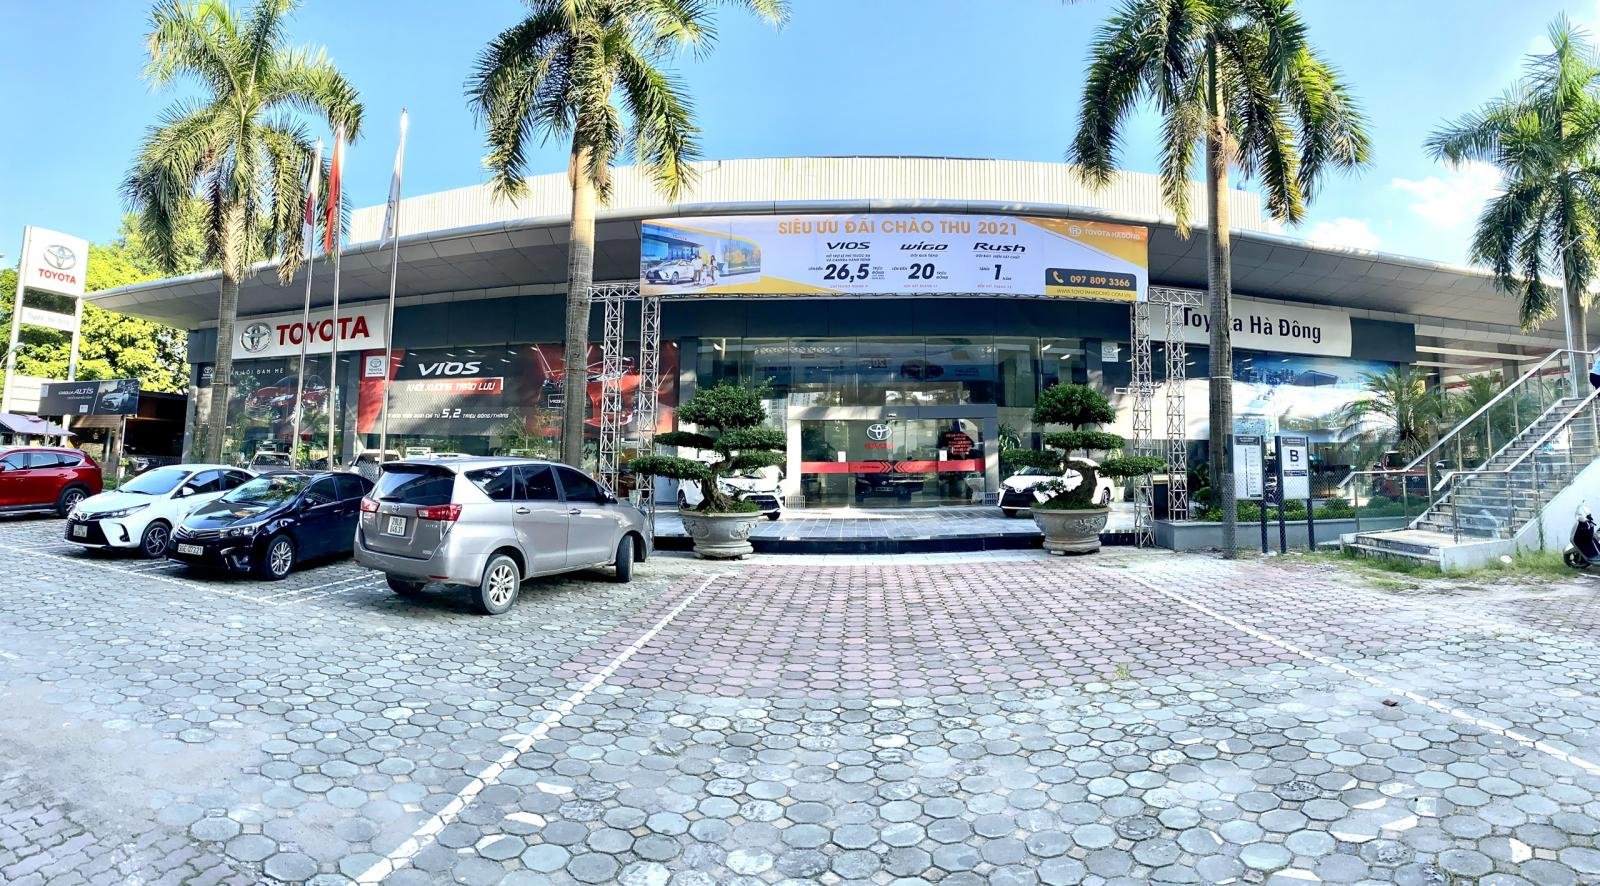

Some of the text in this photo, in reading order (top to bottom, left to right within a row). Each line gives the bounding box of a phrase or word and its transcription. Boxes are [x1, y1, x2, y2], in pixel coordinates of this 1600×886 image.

[778, 217, 1017, 236] SIÊU ƯU ĐÃI CHÀO THU 2021
[827, 241, 871, 250] VIOS
[973, 242, 1026, 253] Rush
[38, 268, 77, 286] TOYOTA
[823, 264, 869, 283] 26,5
[908, 263, 935, 280] 20
[994, 264, 1002, 280] 1
[1070, 275, 1130, 287] 097 809 3366
[276, 316, 370, 346] TOYOTA
[1182, 306, 1321, 344] Toya Hà Đông
[418, 361, 482, 377] VIOS
[1289, 449, 1300, 462] B
